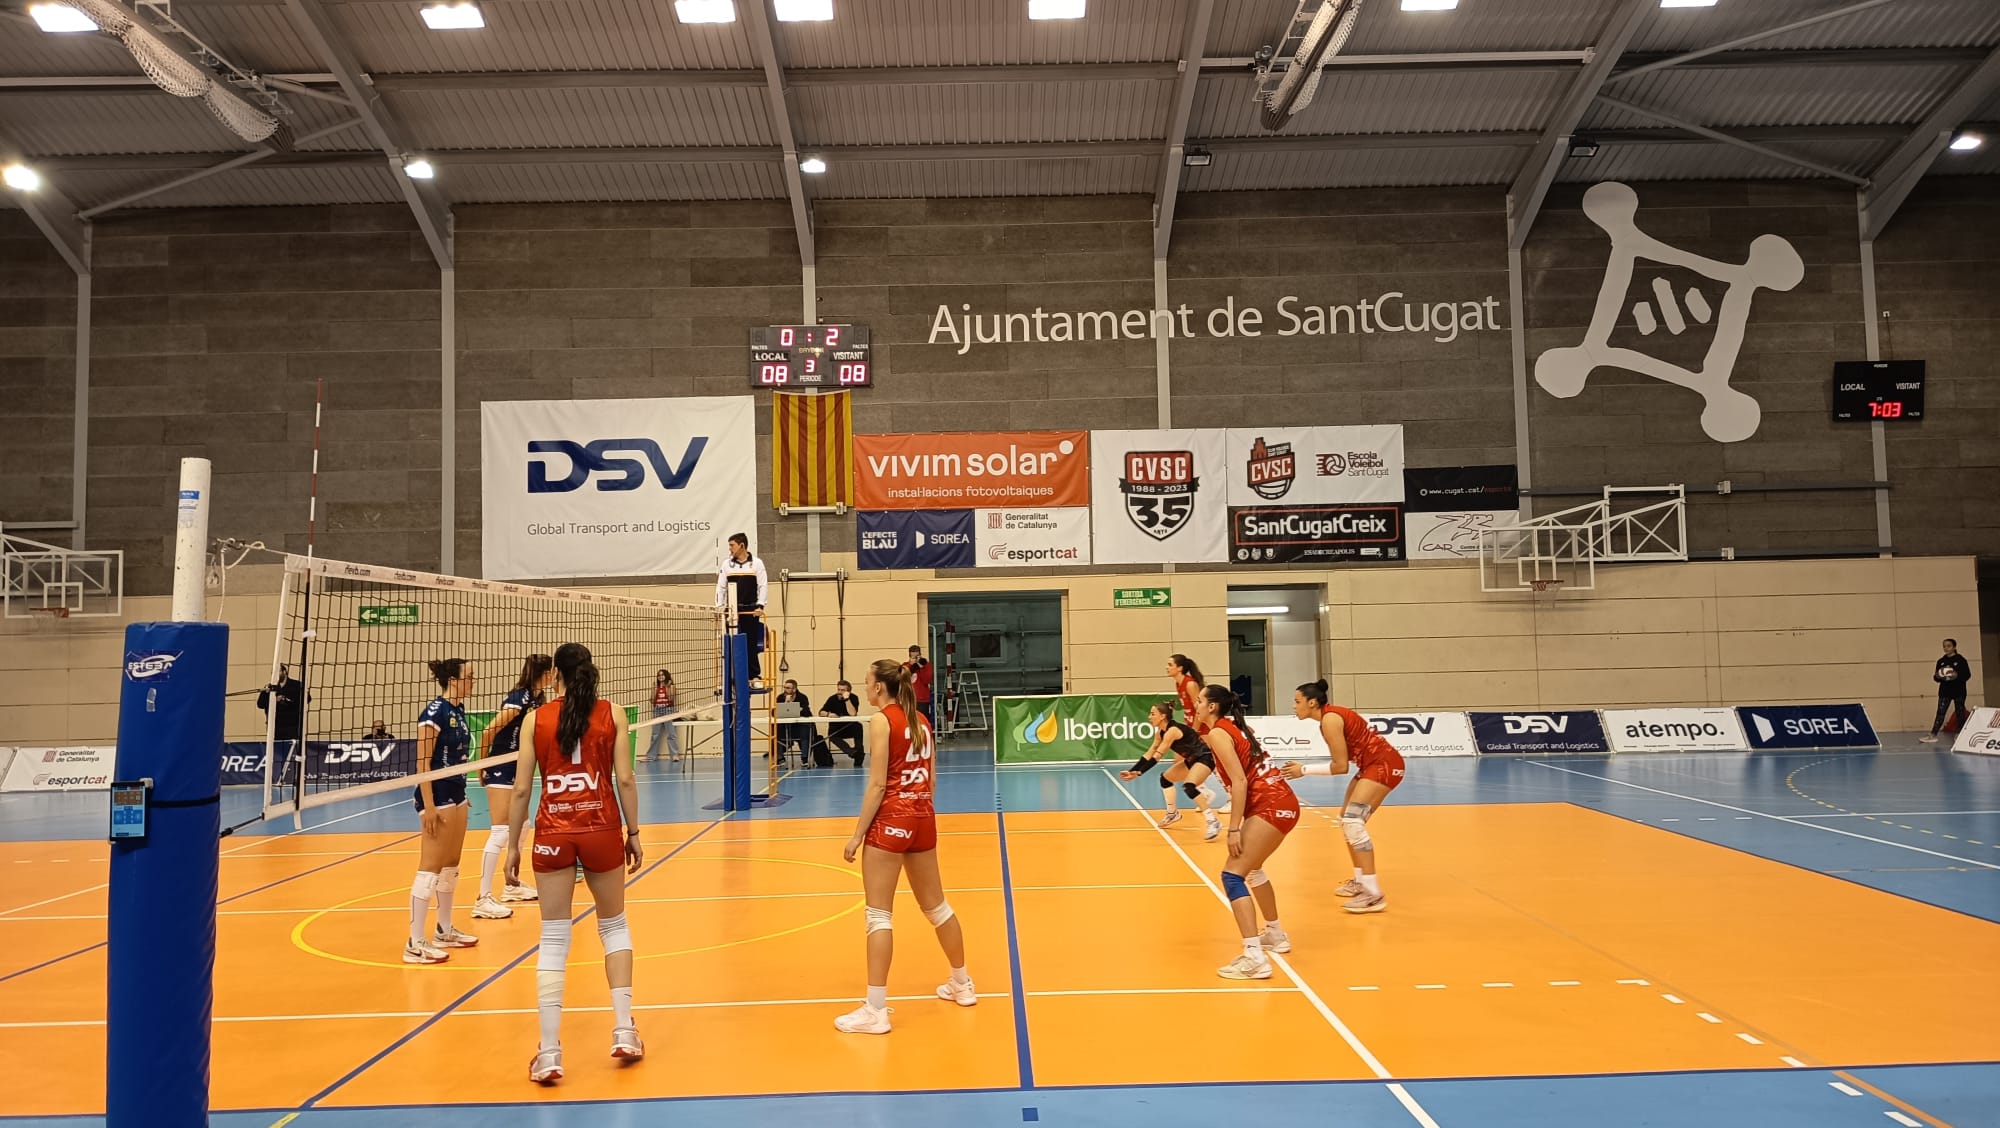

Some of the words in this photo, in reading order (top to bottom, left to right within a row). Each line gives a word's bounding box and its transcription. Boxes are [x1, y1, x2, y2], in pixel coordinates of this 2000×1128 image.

[928, 303, 1195, 354] Ajuntament
[1207, 296, 1262, 338] de
[1277, 292, 1500, 343] SantCugat
[781, 329, 794, 346] 0
[826, 329, 839, 346] 2
[755, 353, 787, 361] LOCAL
[833, 352, 864, 360] VISITANT
[806, 360, 815, 372] 3
[762, 365, 787, 383] 08
[840, 365, 865, 382] 08
[1840, 383, 1865, 391] LOCAL
[1896, 382, 1920, 390] VISITANT
[1868, 402, 1901, 417] 7:03
[1347, 452, 1378, 460] Escola
[528, 436, 709, 493] DSV
[868, 453, 961, 478] vivim
[1131, 457, 1187, 481] CVSC
[1251, 457, 1292, 482] CVSC
[1348, 460, 1383, 468] Voleibol
[1348, 468, 1367, 476] Sant
[1367, 468, 1389, 478] Cugat
[966, 485, 1054, 499] fotovoltaiques
[1164, 484, 1188, 492] 2023
[1129, 495, 1190, 528] 35
[527, 522, 565, 535] Global
[569, 521, 628, 535] Transport
[632, 521, 654, 533] and
[658, 519, 711, 533] Logistics
[1017, 521, 1058, 530] Catalunya
[1245, 514, 1387, 539] SantCugatCreix
[862, 539, 897, 549] BLAU
[930, 533, 970, 545] SOREA
[1008, 546, 1078, 562] esportcat
[1369, 717, 1435, 735] DSV
[1503, 715, 1568, 734] DSV
[1625, 720, 1725, 740] atempo.
[1783, 717, 1860, 735] SOREA
[324, 742, 396, 763] DSV
[1430, 744, 1465, 752] Logistics
[1512, 742, 1549, 751] Transport
[1565, 742, 1600, 751] Logistics
[58, 750, 96, 758] Generalitat
[47, 774, 108, 787] esportcat
[546, 771, 600, 794] DSV
[1275, 808, 1297, 819] DSV
[884, 826, 912, 839] DSV
[534, 844, 560, 856] DSV
